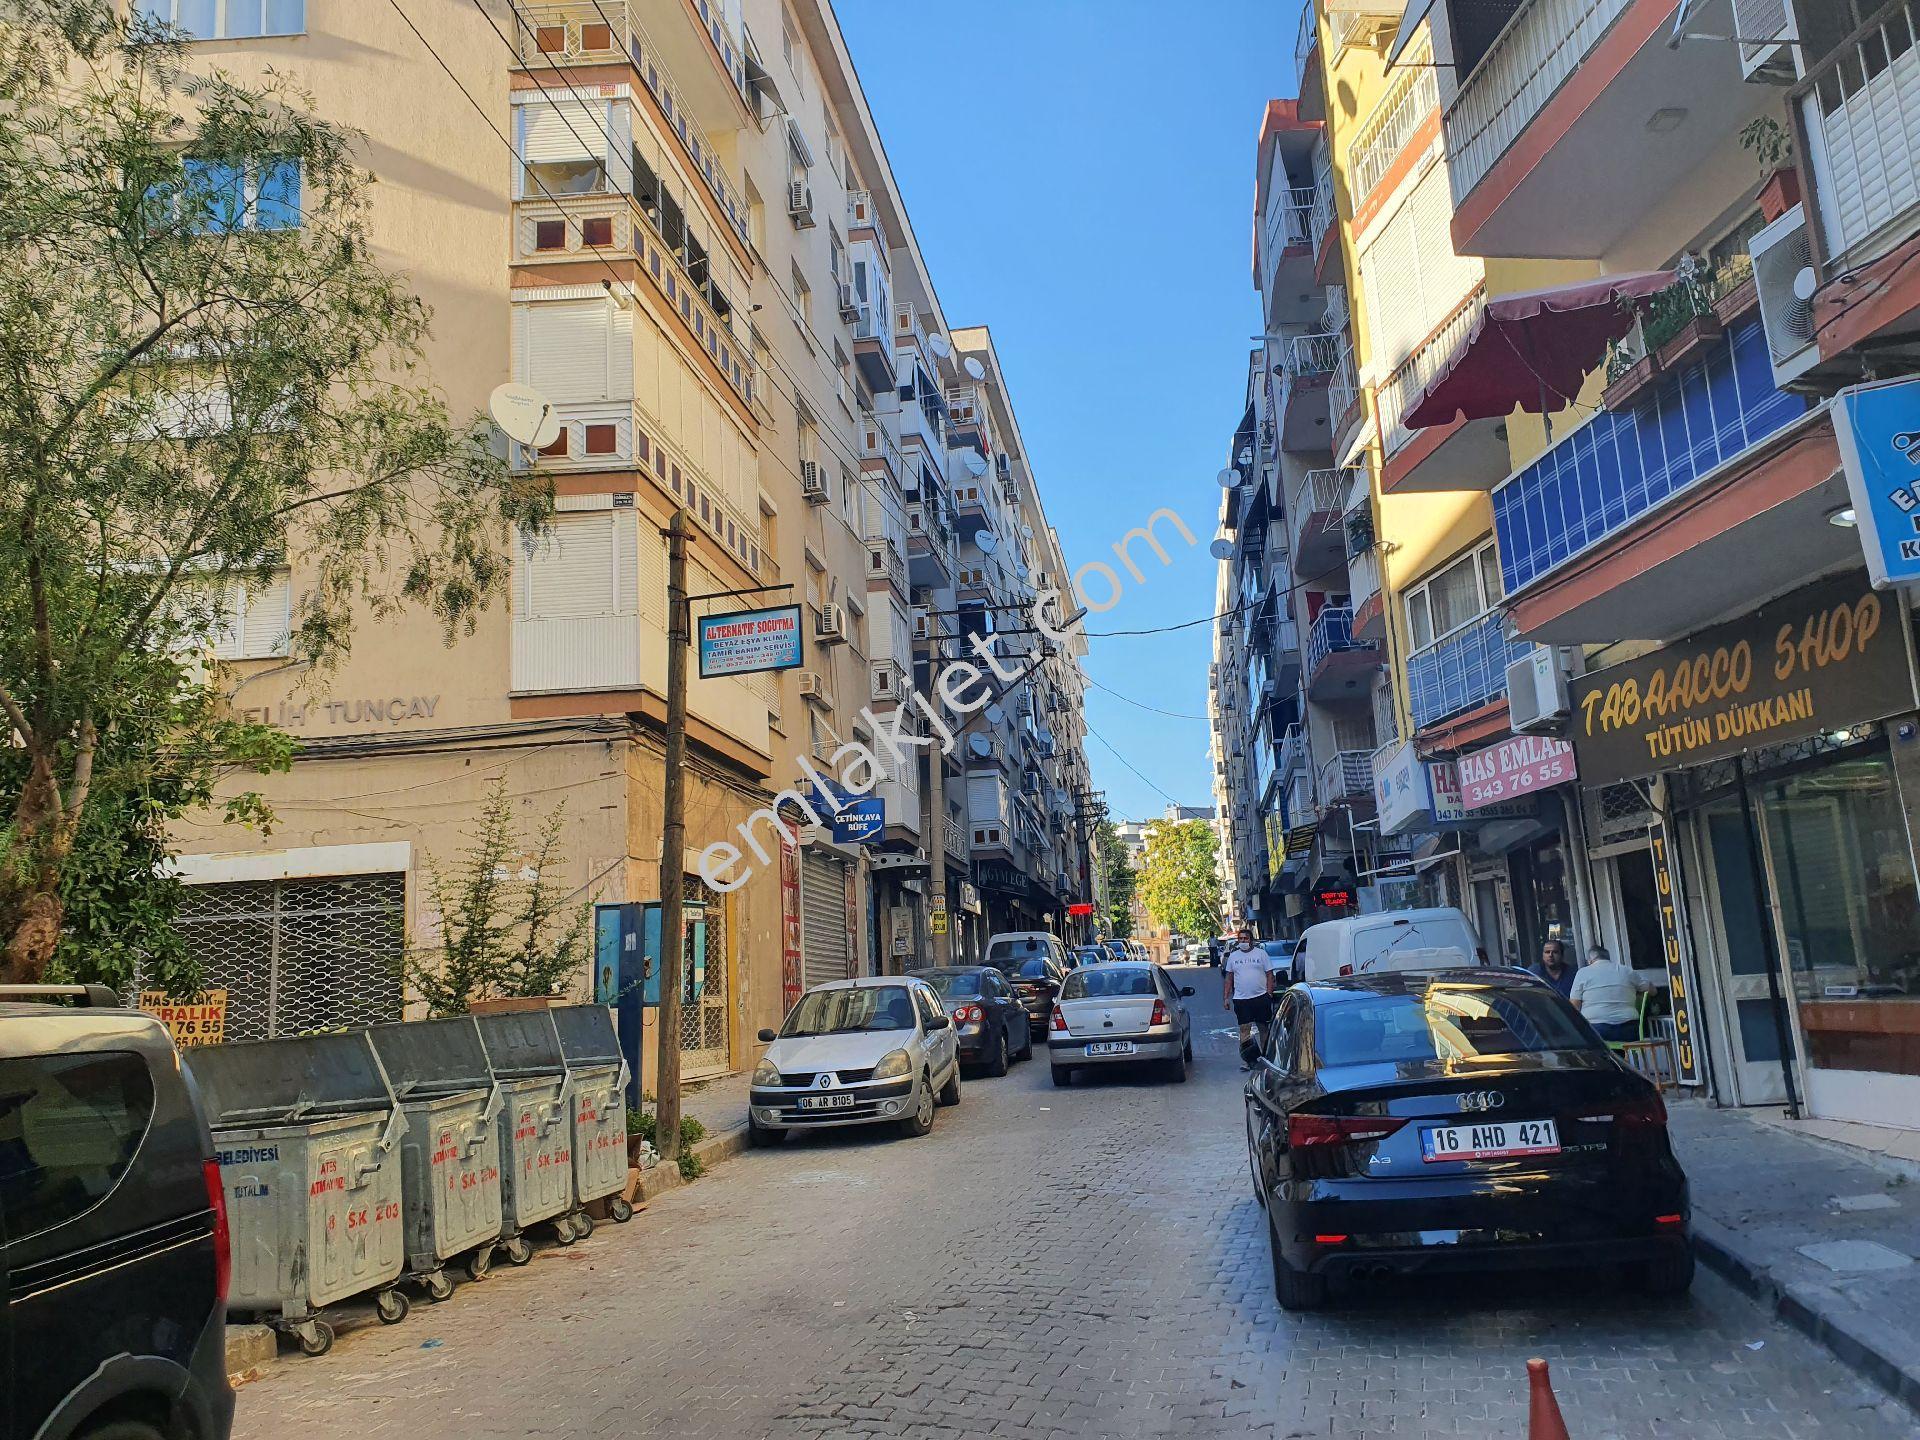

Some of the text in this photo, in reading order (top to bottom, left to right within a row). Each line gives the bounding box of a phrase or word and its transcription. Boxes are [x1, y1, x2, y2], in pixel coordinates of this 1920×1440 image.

[706, 620, 755, 639] ALTERNATİF
[714, 633, 788, 649] BEYAZ EŞYA KLİMA
[707, 649, 734, 658] TAMİR
[735, 647, 761, 655] BAKIM
[1581, 593, 1881, 736] TABAACCO SHOP
[234, 694, 441, 727] ELİH TUNÇAY
[1645, 688, 1814, 758] TÜTÜN DÜKKANI
[1459, 751, 1496, 787] HAS
[1433, 764, 1461, 794] HA
[1472, 760, 1563, 801] 343 76 55
[835, 813, 882, 824] ÇETİNKAYA
[1437, 809, 1451, 820] 343
[848, 822, 869, 831] BÜFE
[1653, 838, 1692, 1070] TÜTÜNCÜ
[142, 994, 171, 1007] HAS
[140, 1007, 222, 1020] İRALIK
[176, 1021, 196, 1034] 76
[201, 1020, 221, 1033] 55
[1115, 1042, 1128, 1051] 279
[802, 1095, 851, 1108] 06 AR 8105
[1436, 1122, 1553, 1151] 16 AHD 421
[1369, 1154, 1392, 1165] A3
[348, 1208, 368, 1229] S.K
[375, 1202, 400, 1222] 203
